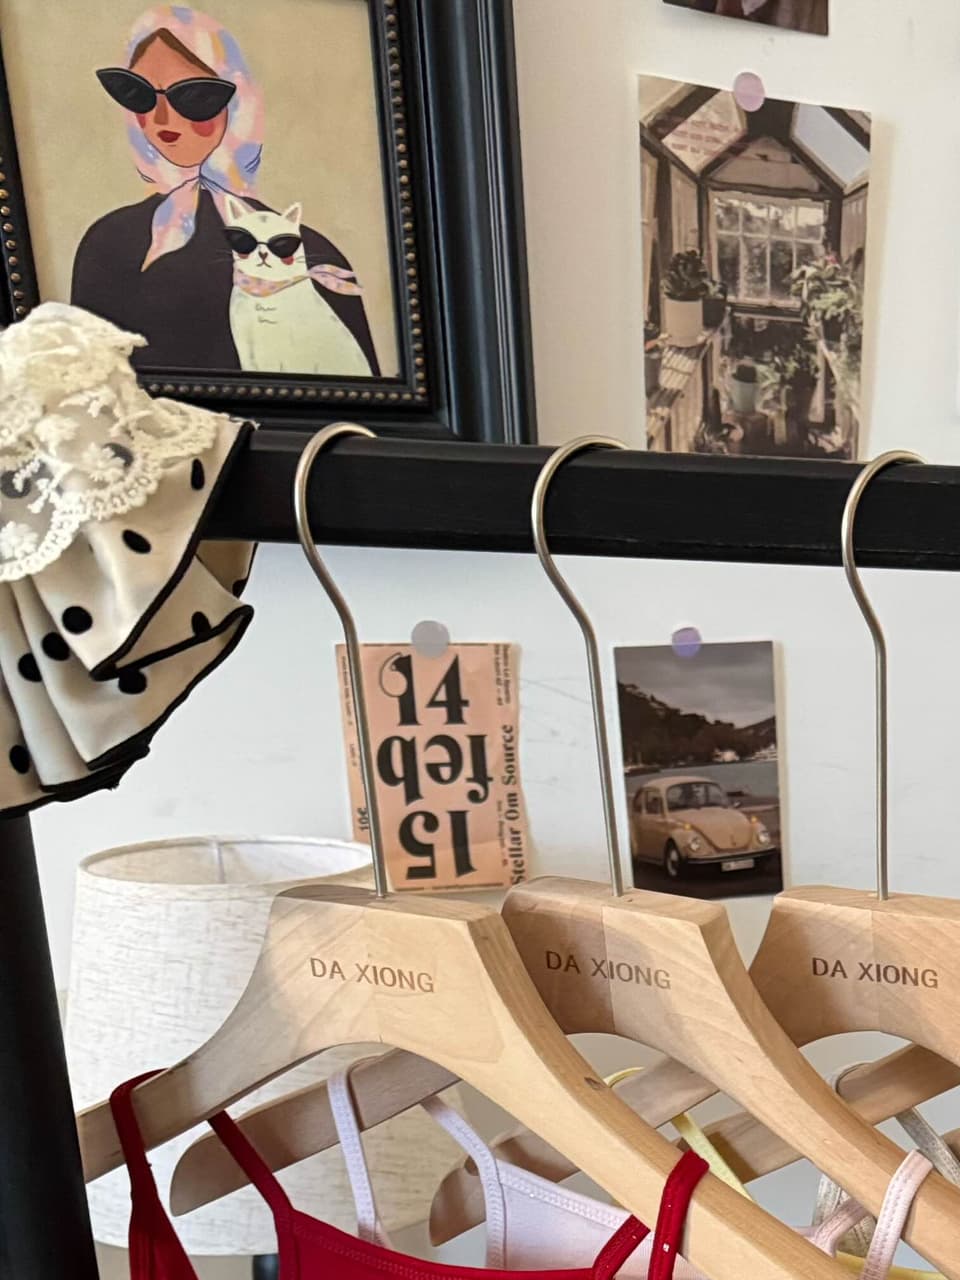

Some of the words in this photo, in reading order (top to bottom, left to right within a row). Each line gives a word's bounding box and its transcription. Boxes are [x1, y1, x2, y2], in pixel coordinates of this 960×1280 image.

[379, 652, 470, 726] 14
[501, 724, 517, 786] Source
[504, 792, 519, 821] Om
[310, 956, 346, 981] DA
[355, 963, 435, 993] XIONG
[545, 950, 580, 974] DA
[591, 957, 671, 990] XIONG
[812, 957, 848, 980] DA
[857, 962, 938, 989] XIONG
